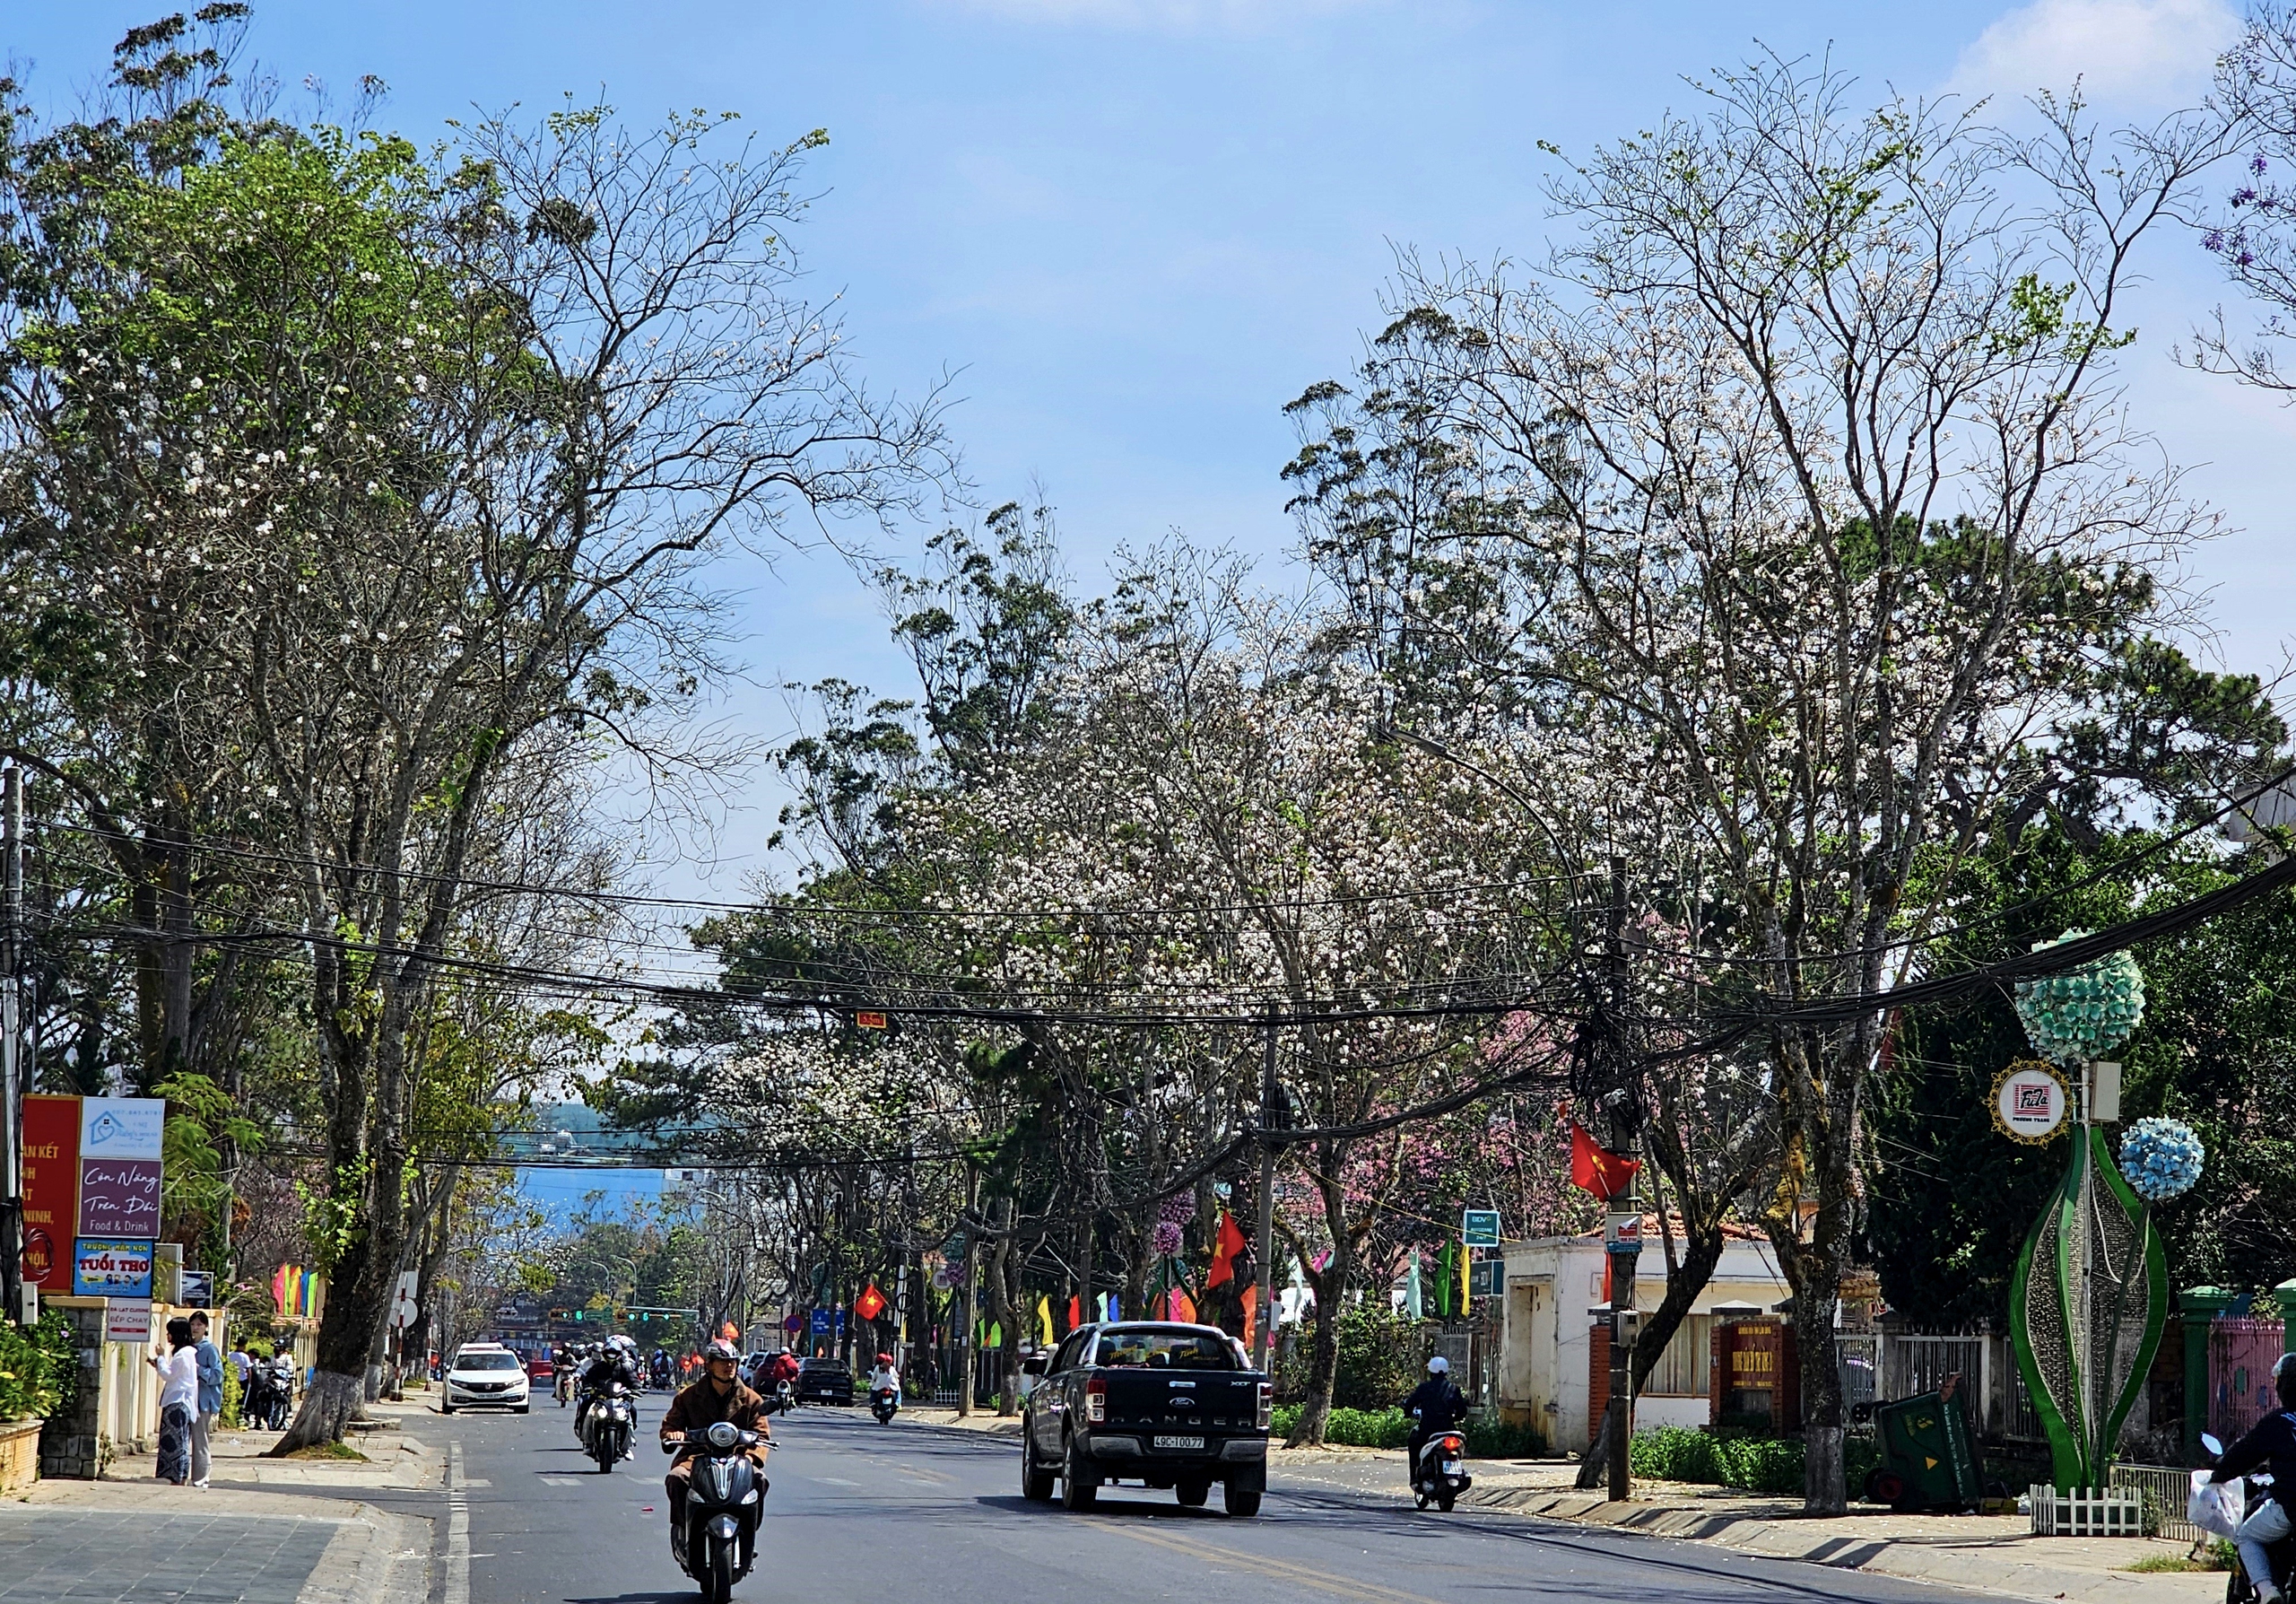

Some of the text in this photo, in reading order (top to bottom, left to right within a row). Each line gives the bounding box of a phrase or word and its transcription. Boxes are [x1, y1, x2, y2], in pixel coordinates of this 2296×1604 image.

[22, 1141, 59, 1159] ÀN KẾT
[22, 1209, 54, 1225] NINH,
[90, 1219, 149, 1233] Food & Drink
[118, 1259, 150, 1273] THƠ
[126, 1316, 149, 1324] CHAY
